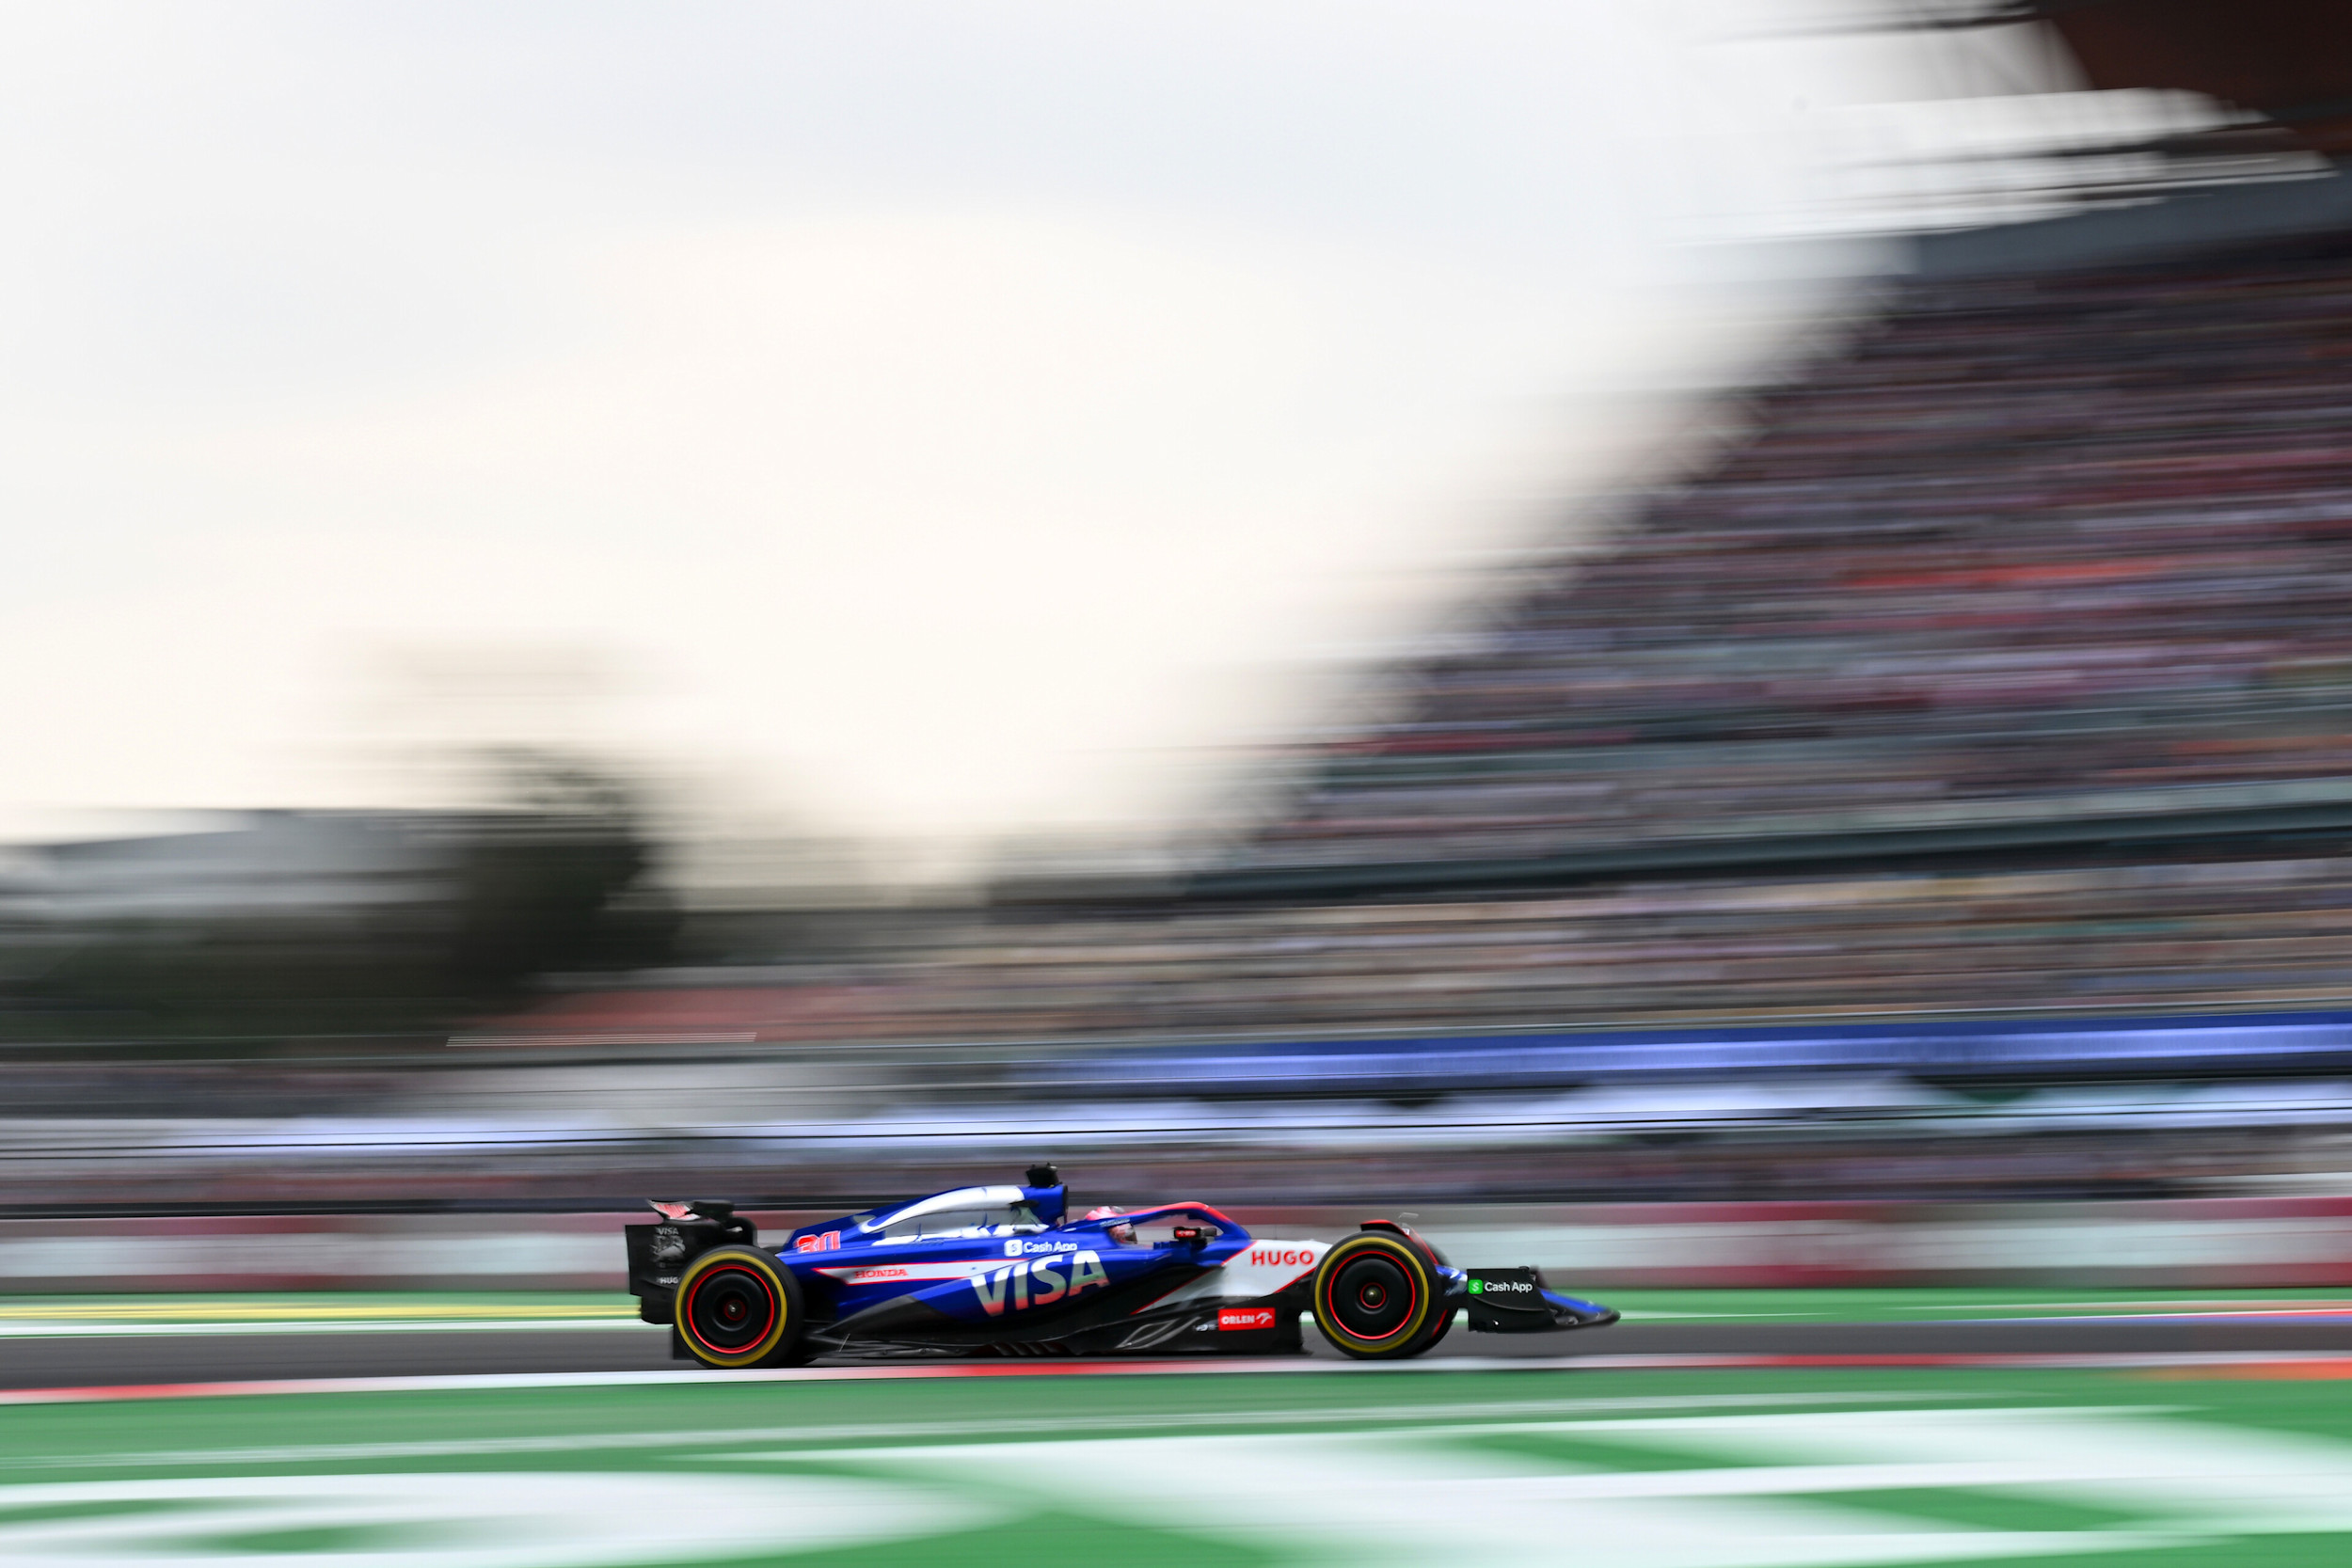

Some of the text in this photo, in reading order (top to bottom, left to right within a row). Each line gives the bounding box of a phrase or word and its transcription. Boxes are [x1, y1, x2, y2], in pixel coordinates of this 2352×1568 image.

[1024, 1241, 1078, 1253] Cash App
[1250, 1249, 1314, 1266] HUGO
[853, 1269, 910, 1279] HONDA
[660, 1276, 682, 1285] HUG
[970, 1250, 1111, 1317] VISA
[1484, 1281, 1534, 1293] Cash App
[1221, 1315, 1256, 1325] ORLEN
